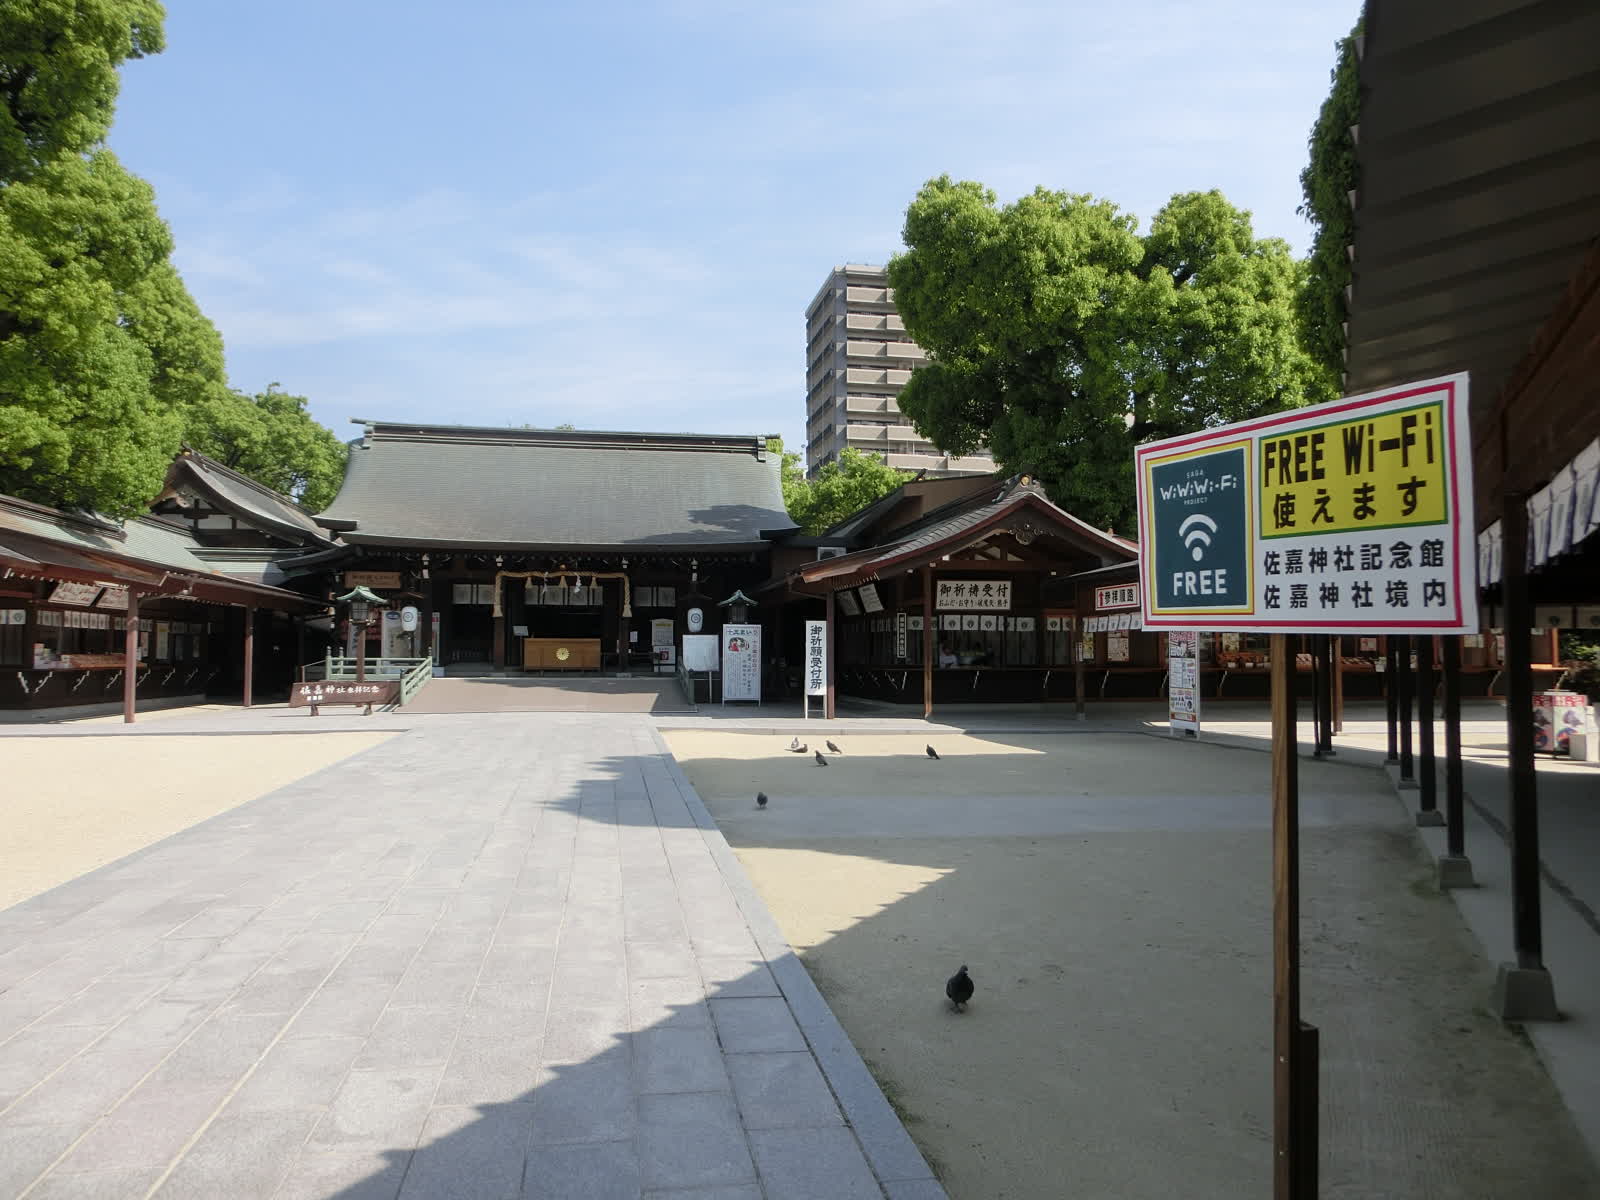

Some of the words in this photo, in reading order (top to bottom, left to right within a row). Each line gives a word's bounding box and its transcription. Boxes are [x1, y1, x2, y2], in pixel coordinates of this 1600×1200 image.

[1264, 432, 1325, 488] FREE
[1342, 411, 1434, 476] Wi-Fi
[1186, 469, 1204, 479] SAGA
[1183, 497, 1208, 505] PROJECT
[1273, 475, 1427, 529] 使えます
[1263, 539, 1444, 576] 佐嘉神社記念館
[1173, 568, 1227, 596] FREE
[1263, 578, 1446, 610] 佐嘉神社境内
[810, 624, 823, 690] 御祈願受付所
